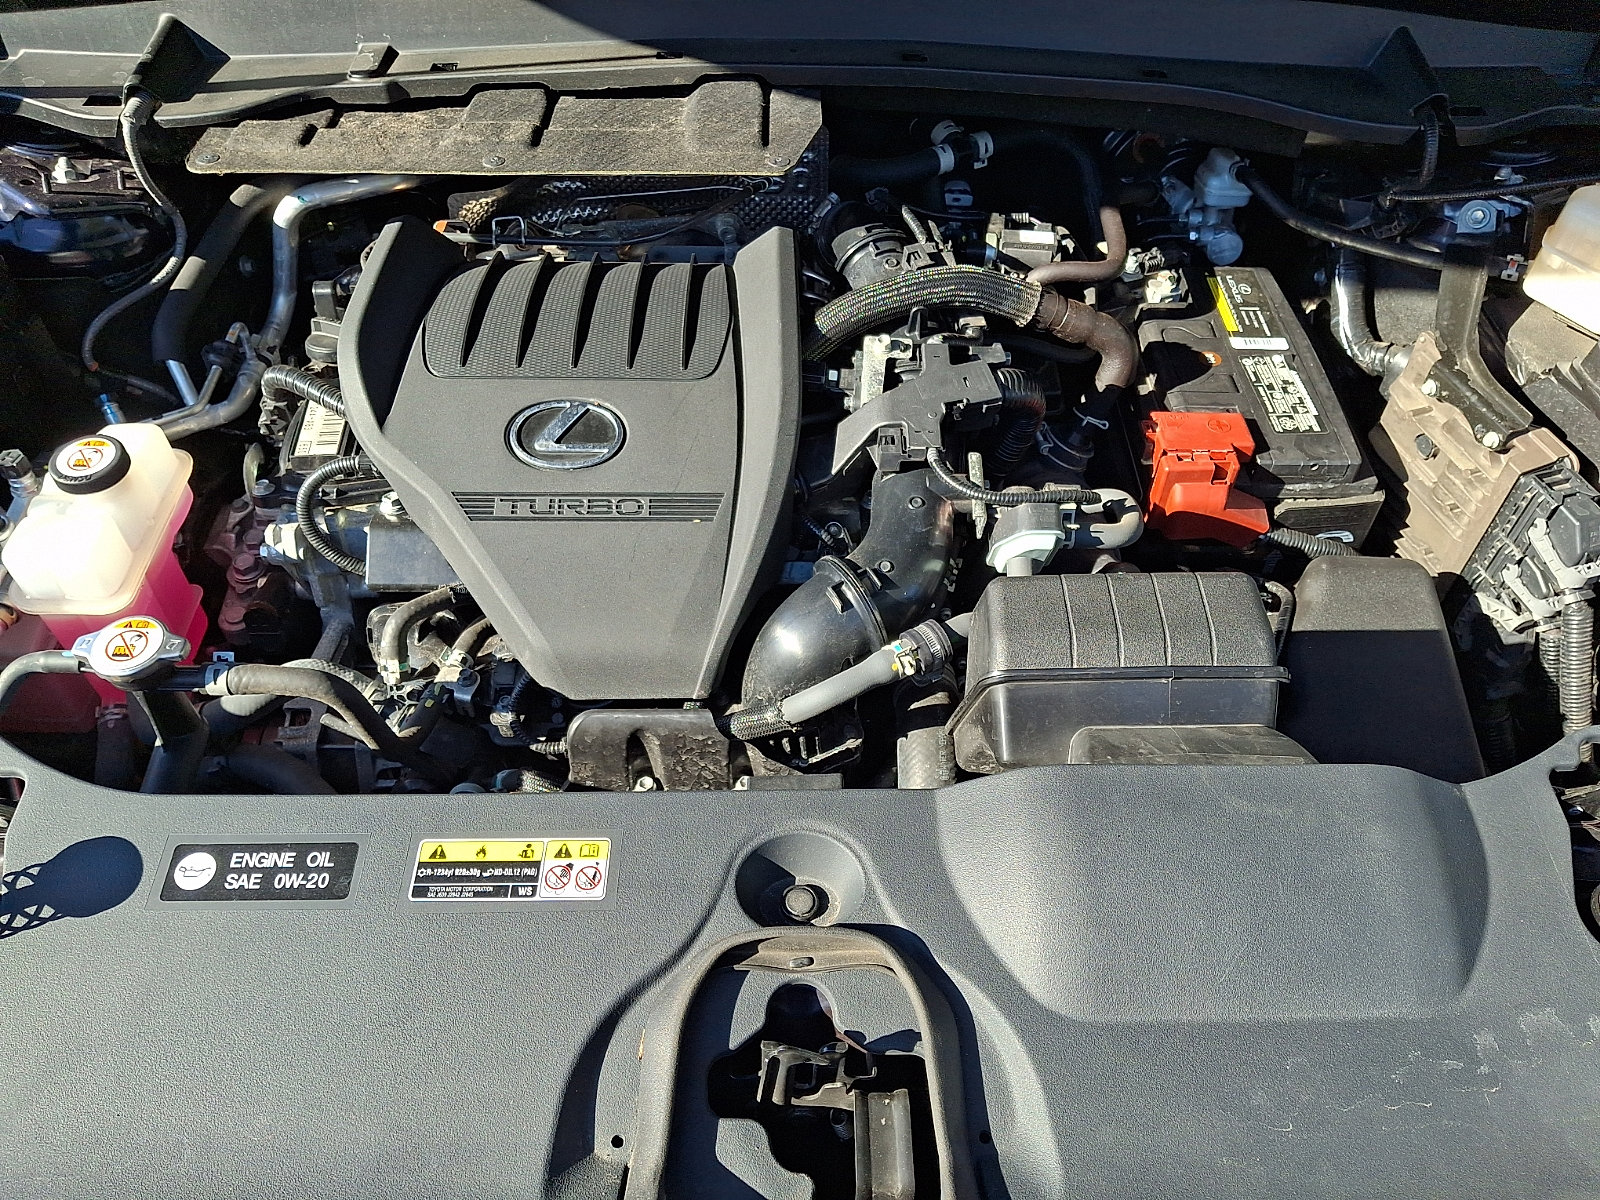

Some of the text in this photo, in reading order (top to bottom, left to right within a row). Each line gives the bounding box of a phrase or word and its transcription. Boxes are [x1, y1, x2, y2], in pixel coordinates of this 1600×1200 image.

[1226, 275, 1244, 304] LEXUS
[498, 497, 647, 516] TURBO
[229, 851, 335, 868] ENGINE OIL
[224, 873, 330, 890] SAE 0W-20
[518, 886, 533, 896] WS
